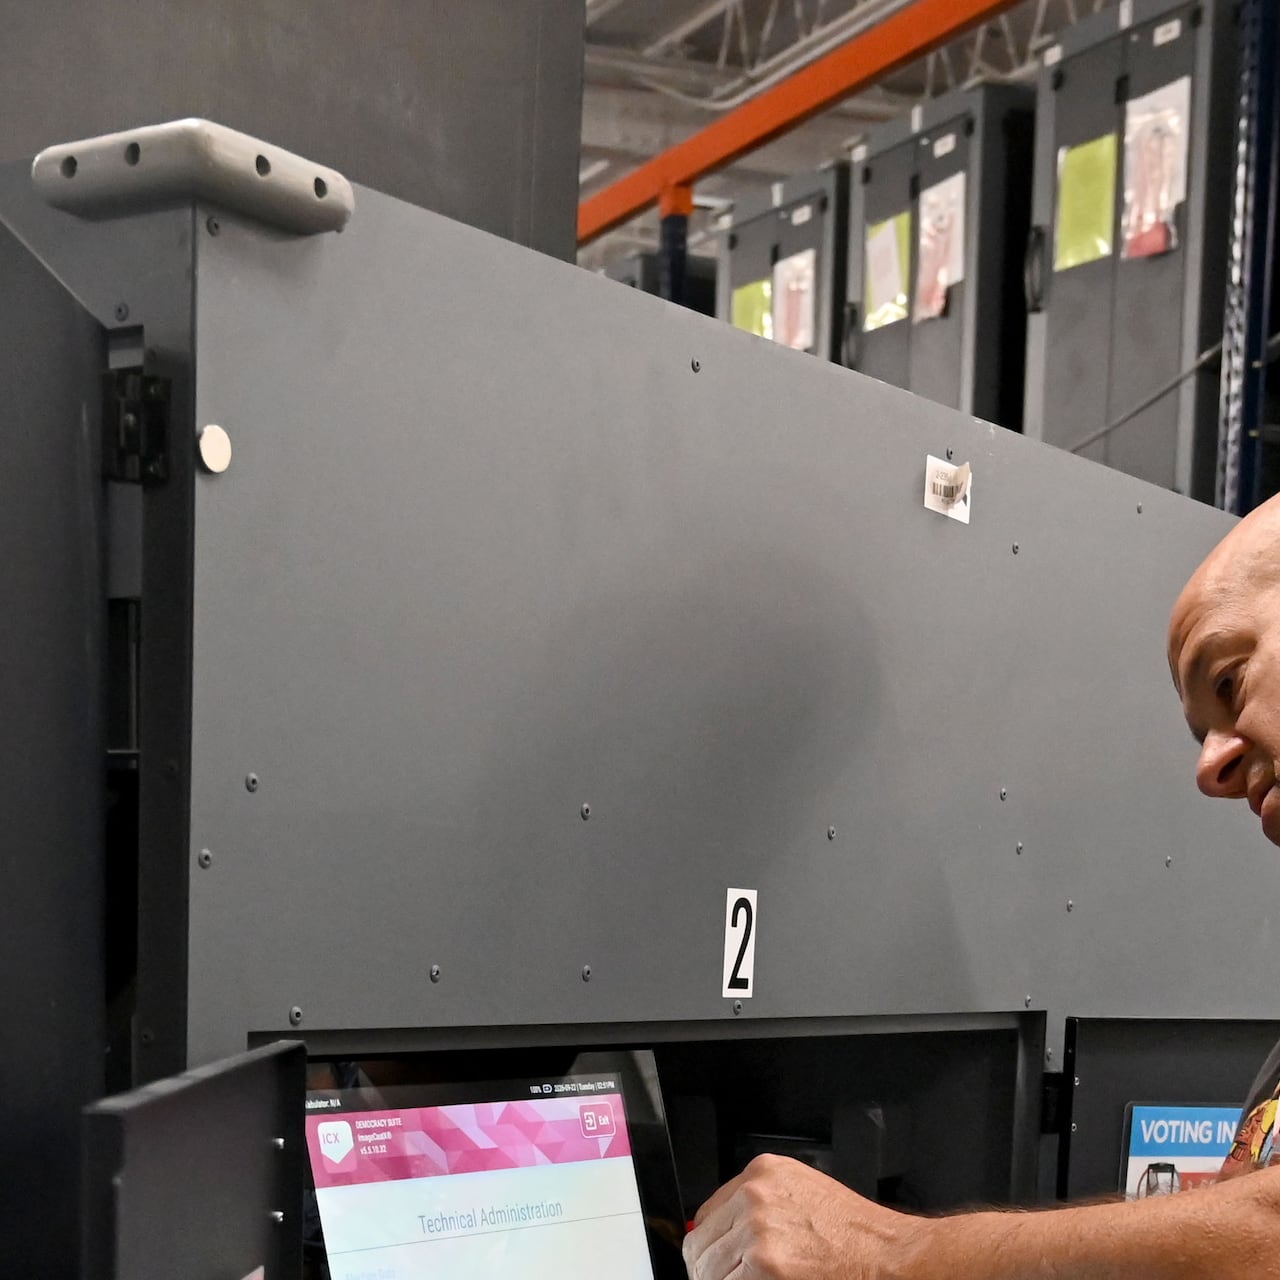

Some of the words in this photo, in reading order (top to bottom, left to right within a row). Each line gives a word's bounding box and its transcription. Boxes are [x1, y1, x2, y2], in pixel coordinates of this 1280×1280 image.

[728, 897, 753, 990] 2
[355, 1119, 386, 1129] DEMOCRACY
[387, 1118, 402, 1126] SUITE
[598, 1115, 610, 1126] Exit
[322, 1132, 340, 1144] ICX
[1141, 1120, 1212, 1144] VOTING
[418, 1207, 478, 1234] Technical
[480, 1200, 563, 1227] Administration
